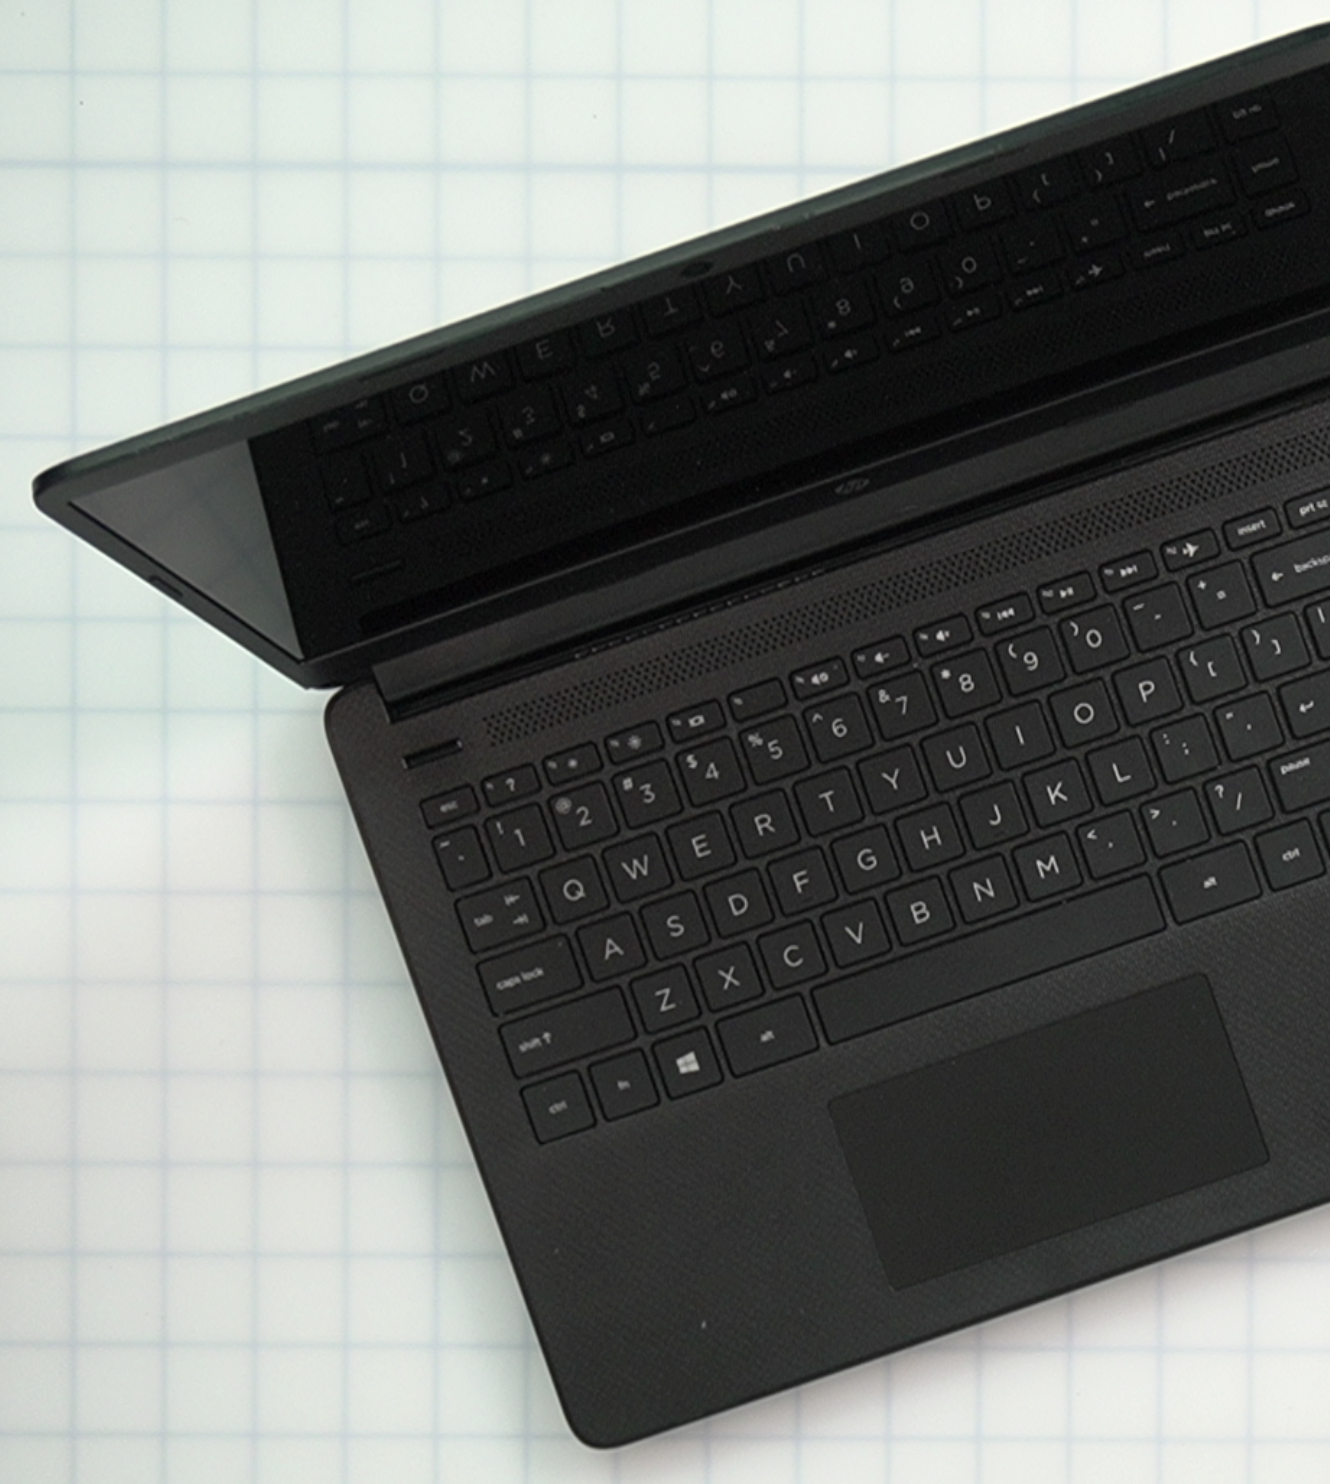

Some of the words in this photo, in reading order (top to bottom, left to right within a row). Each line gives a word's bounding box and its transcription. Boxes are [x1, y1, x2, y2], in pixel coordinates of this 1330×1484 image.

[1023, 651, 1039, 671] 9
[958, 673, 975, 693] 8
[1138, 680, 1155, 703] P
[895, 695, 908, 715] 7
[1073, 702, 1095, 724] O
[831, 718, 848, 738] 6
[767, 739, 783, 760] 5
[946, 746, 967, 769] U
[705, 762, 719, 779] 4
[881, 768, 899, 790] Y
[1112, 763, 1131, 783] L
[639, 783, 656, 804] 3
[818, 790, 834, 812] T
[1046, 781, 1068, 805] K
[576, 805, 592, 827] 2
[754, 813, 775, 836] R
[989, 804, 1002, 826] J
[514, 828, 526, 846] 1
[691, 834, 711, 858] E
[920, 826, 942, 850] H
[621, 854, 648, 880] W
[856, 848, 878, 871] G
[1036, 855, 1060, 879] M
[562, 879, 586, 901] Q
[792, 870, 809, 894] F
[972, 878, 995, 902] N
[728, 893, 749, 916] D
[910, 901, 931, 924] B
[666, 915, 685, 937] S
[844, 922, 863, 945] V
[604, 938, 624, 960] A
[783, 944, 804, 968] C
[496, 975, 521, 990] caps
[520, 967, 544, 983] lock
[718, 966, 740, 990] X
[655, 987, 676, 1012] Z
